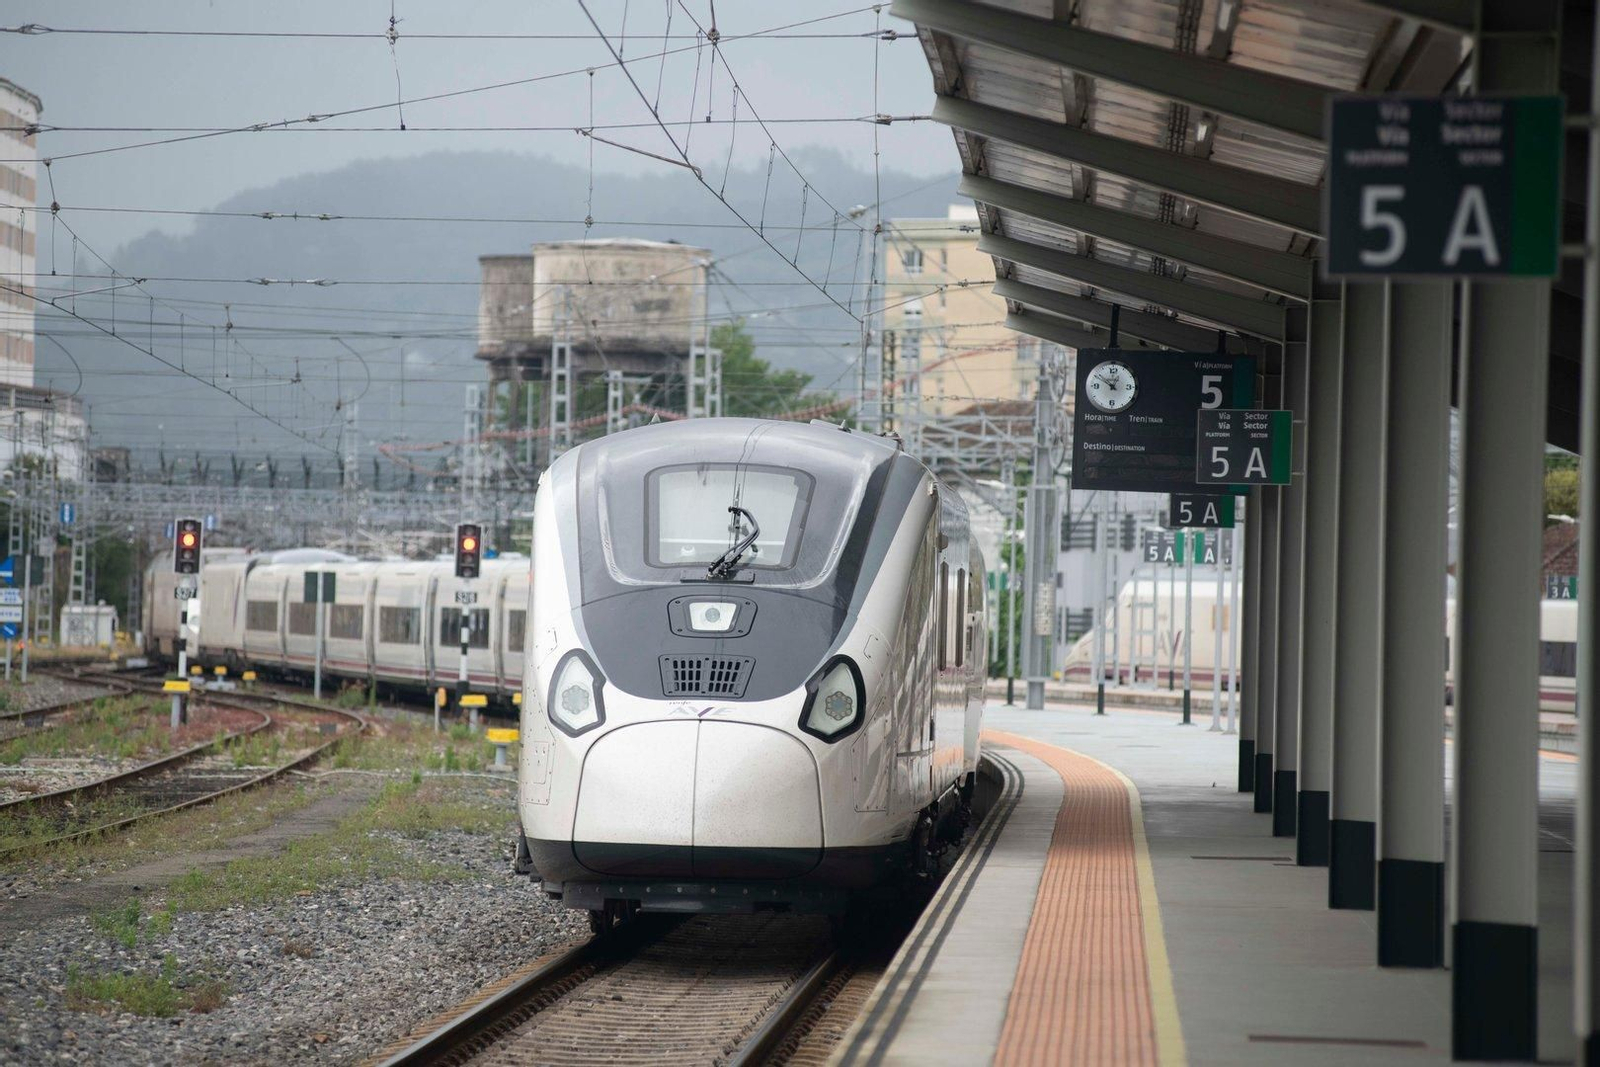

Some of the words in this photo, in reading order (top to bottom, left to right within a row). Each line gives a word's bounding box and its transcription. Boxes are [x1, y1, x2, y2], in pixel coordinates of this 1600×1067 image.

[1360, 185, 1407, 266] 5
[1442, 185, 1501, 266] A
[1201, 375, 1223, 409] 5
[1244, 412, 1268, 420] Sector
[1243, 421, 1268, 430] Sector
[1211, 446, 1229, 478] 5
[1244, 447, 1267, 478] A
[1180, 501, 1193, 524] 5
[1202, 502, 1218, 524] A
[1149, 545, 1159, 562] 5
[1164, 546, 1175, 562] A
[1204, 547, 1215, 563] A
[1551, 586, 1558, 599] 3
[1561, 586, 1570, 599] A
